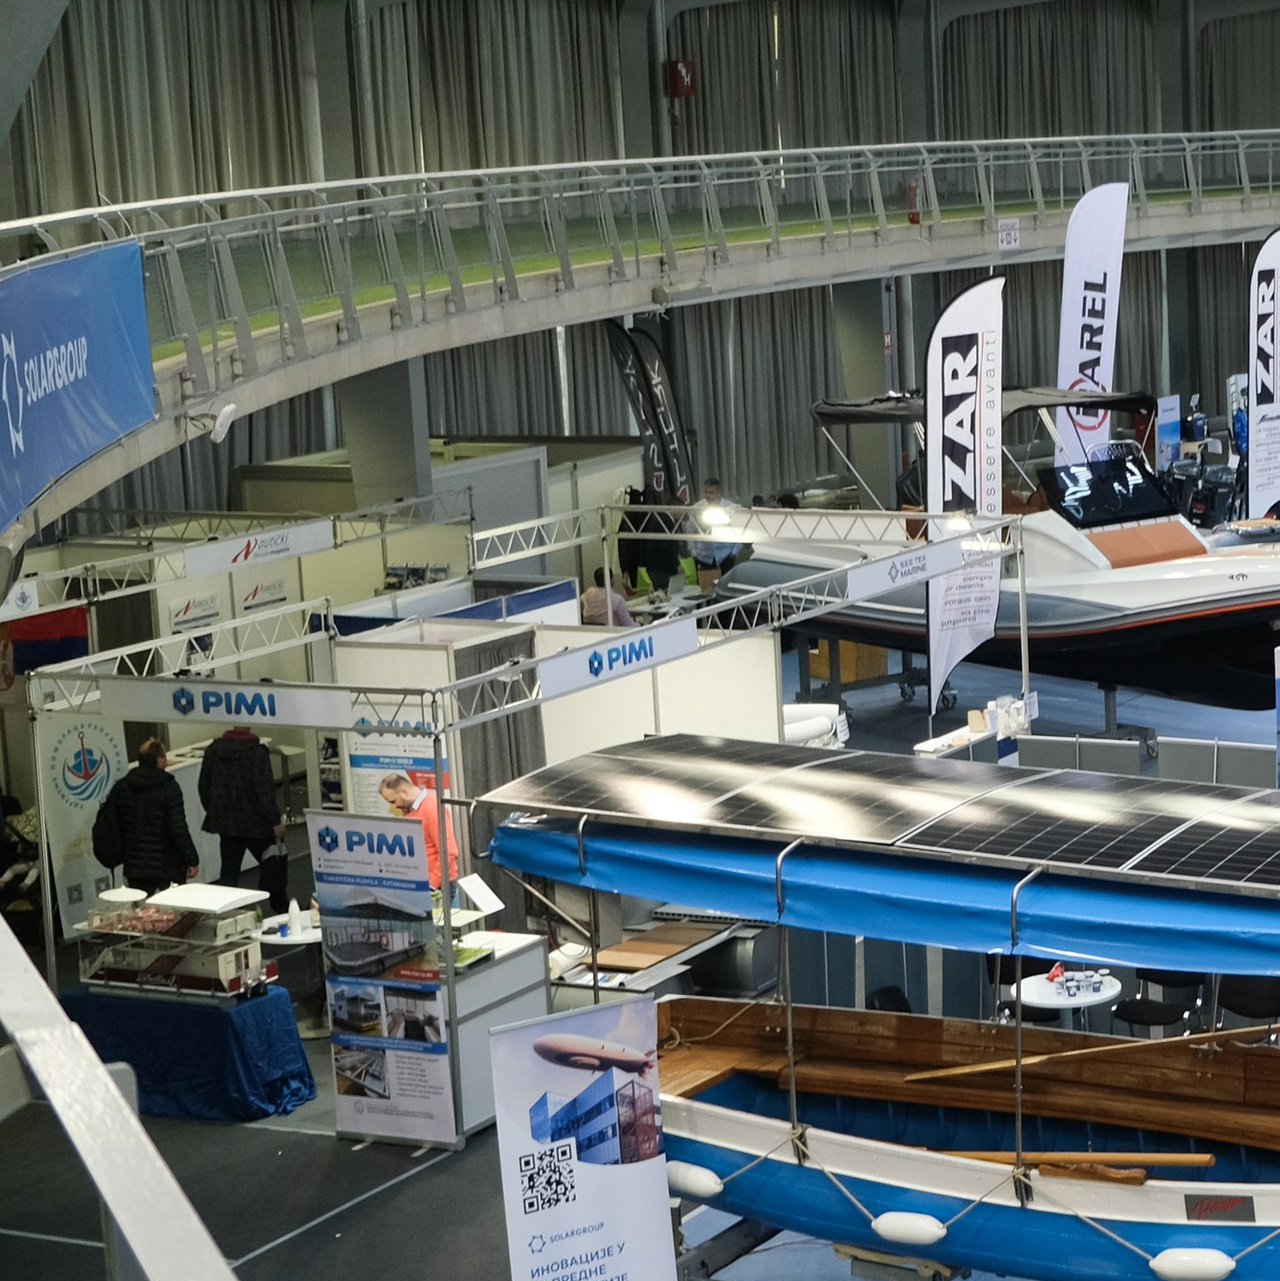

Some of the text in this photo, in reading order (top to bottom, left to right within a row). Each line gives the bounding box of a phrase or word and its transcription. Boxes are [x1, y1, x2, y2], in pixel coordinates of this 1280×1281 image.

[1258, 277, 1275, 395] ZAR
[24, 336, 88, 406] SOLARGROUP
[943, 344, 977, 502] ZAR
[986, 330, 996, 513] essere avanti
[900, 563, 927, 578] MARINE
[608, 637, 655, 671] PIMI
[201, 690, 277, 717] PIMI
[345, 830, 415, 858] PIMI
[550, 1222, 605, 1244] SOLARGROUP
[530, 1242, 626, 1280] ИНОВАЦИЈЕ У
